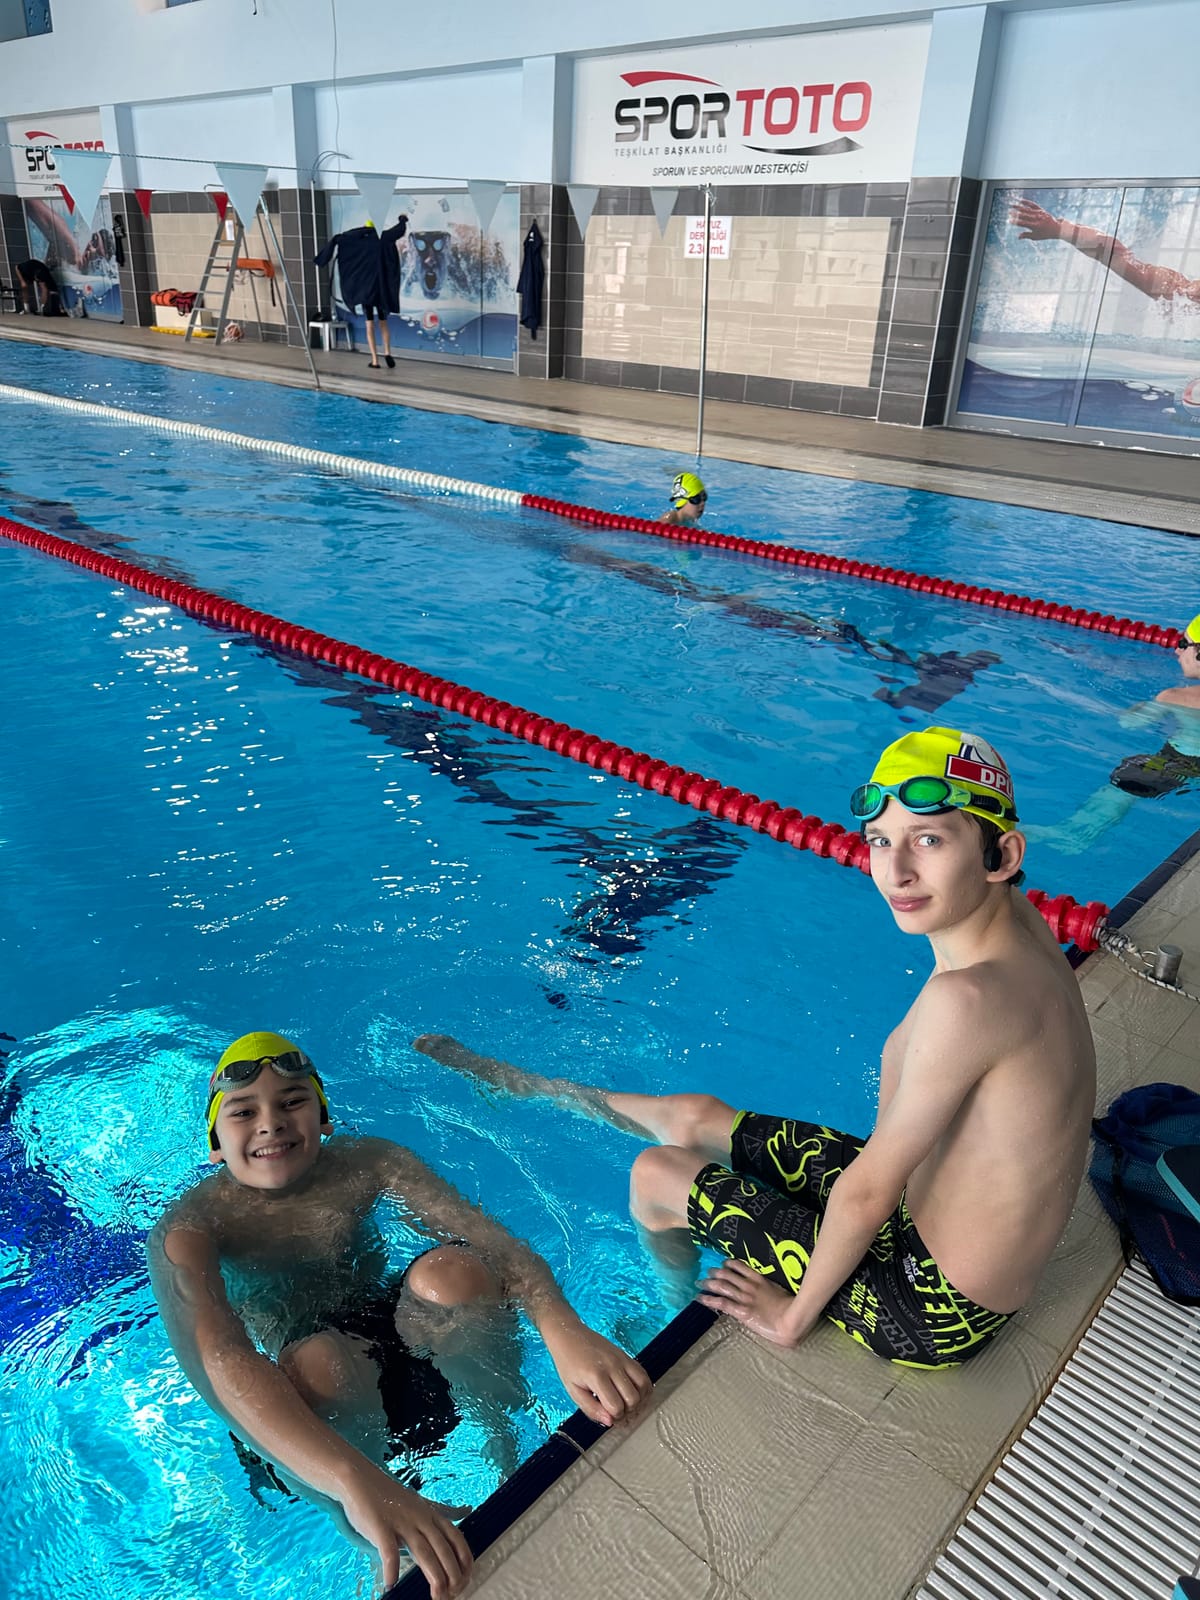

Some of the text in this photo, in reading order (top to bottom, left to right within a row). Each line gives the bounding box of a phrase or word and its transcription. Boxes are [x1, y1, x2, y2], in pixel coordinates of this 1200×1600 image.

[615, 144, 728, 158] TEŞKİLAT BAŞKANLIĞI
[652, 161, 809, 177] SPORUN VE SPORCUNUN DESTEKÇİSİ
[696, 220, 722, 229] HAUZ
[690, 229, 727, 240] DERLİĞİ
[689, 243, 706, 254] 2.3
